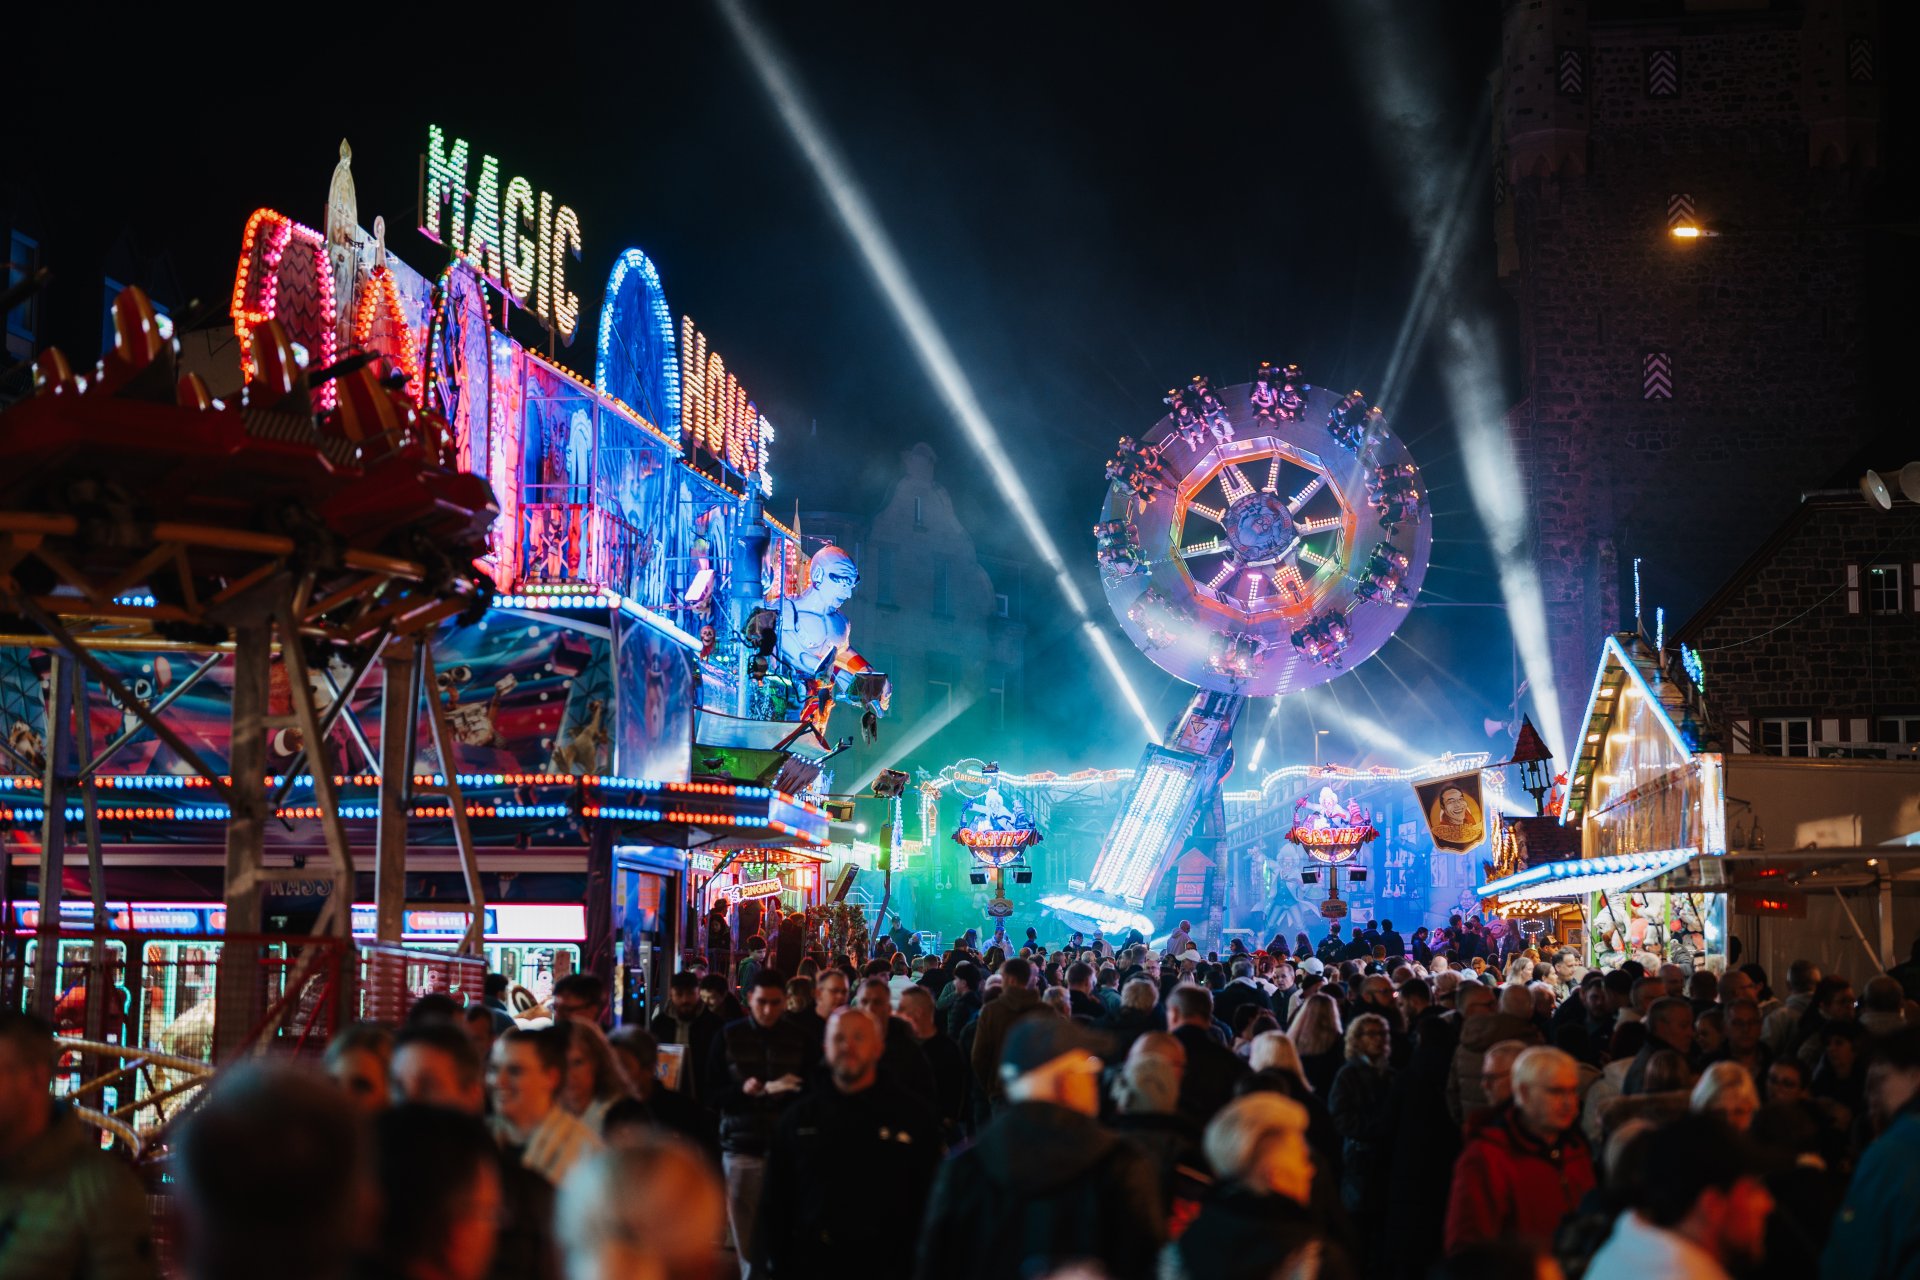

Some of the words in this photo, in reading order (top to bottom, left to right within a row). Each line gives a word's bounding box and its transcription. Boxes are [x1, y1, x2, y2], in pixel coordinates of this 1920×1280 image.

[427, 124, 582, 345] MAGIC
[681, 315, 774, 496] HOUSE
[959, 827, 1031, 848] GRAVITY
[1296, 826, 1370, 846] GRAVITY
[742, 882, 779, 897] EINGANG
[151, 915, 170, 925] DATE
[353, 917, 371, 926] ATE
[417, 916, 438, 926] PINK
[439, 916, 460, 926] DATE
